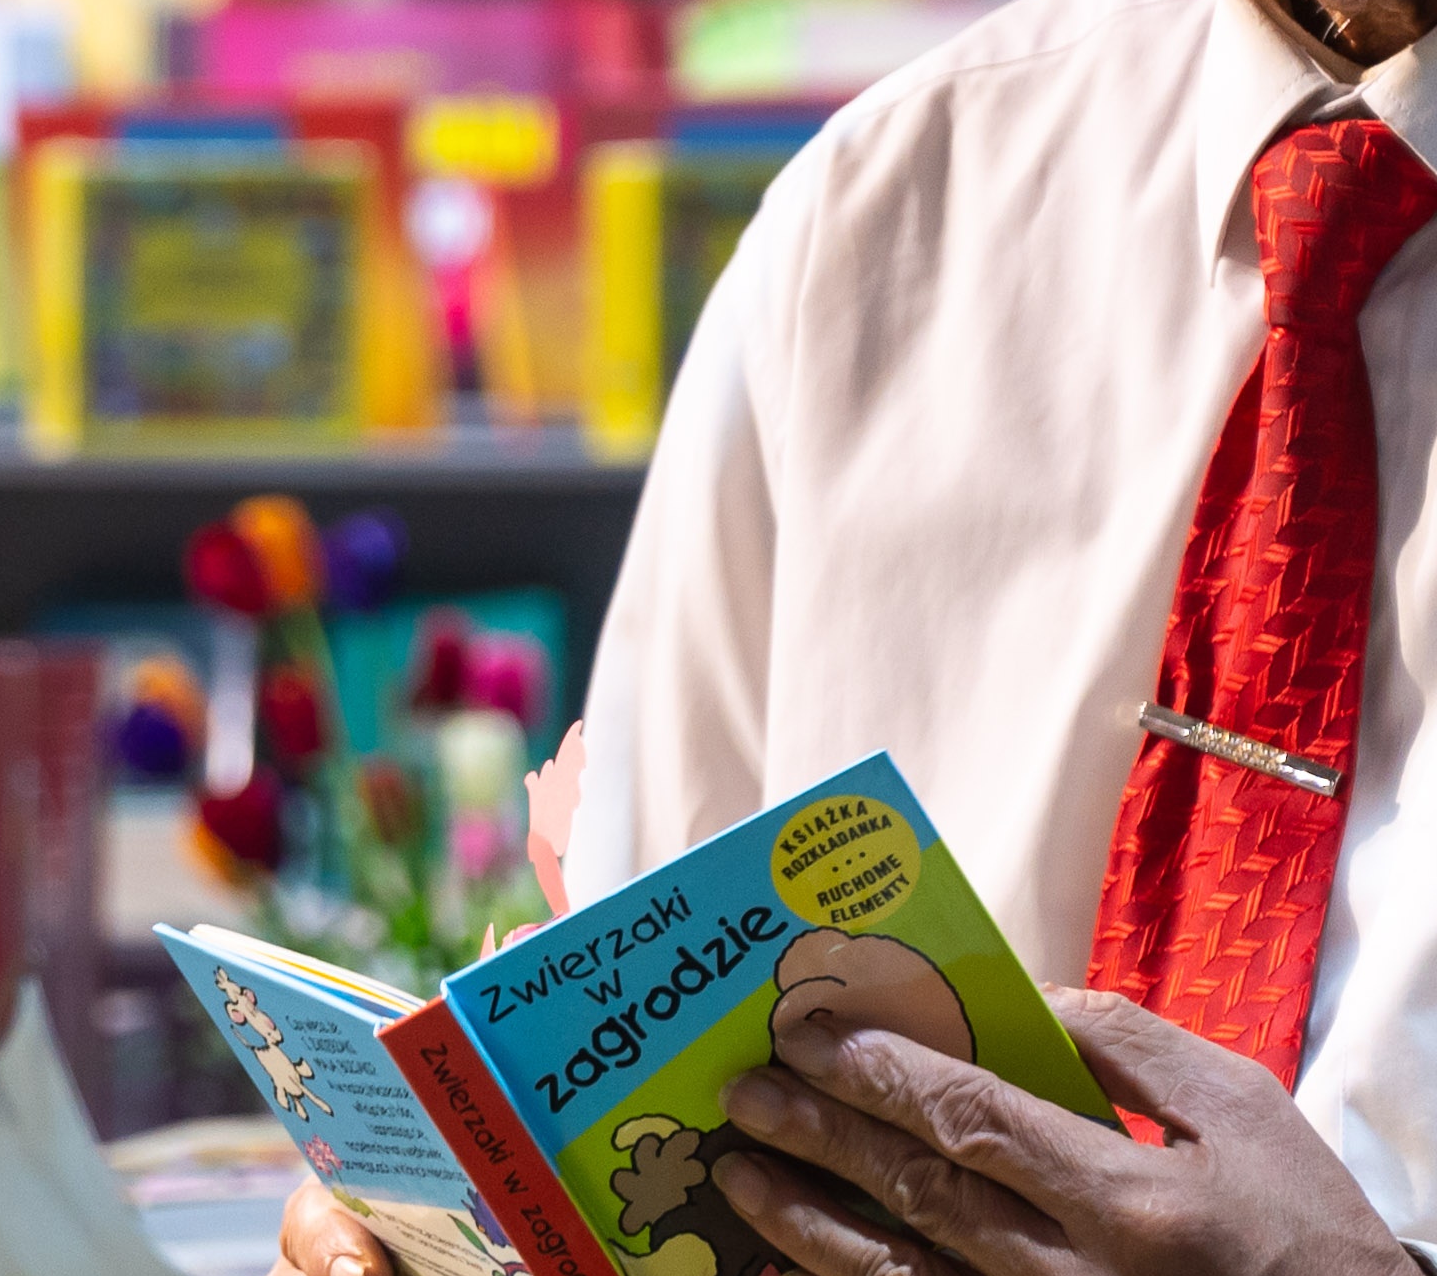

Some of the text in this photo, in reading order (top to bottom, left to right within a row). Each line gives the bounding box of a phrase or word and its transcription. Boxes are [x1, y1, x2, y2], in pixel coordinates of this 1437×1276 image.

[780, 801, 868, 855] KSIĄŻKA
[781, 814, 892, 881] ROZKŁADANKA
[817, 853, 902, 908] RUCHOME
[830, 873, 910, 924] ELEMENTY
[480, 886, 692, 1023] Zwierzaki
[534, 905, 788, 1113] zagrodzie
[583, 969, 623, 1006] w
[420, 1042, 515, 1165] Zwierzaki
[503, 1169, 528, 1194] w
